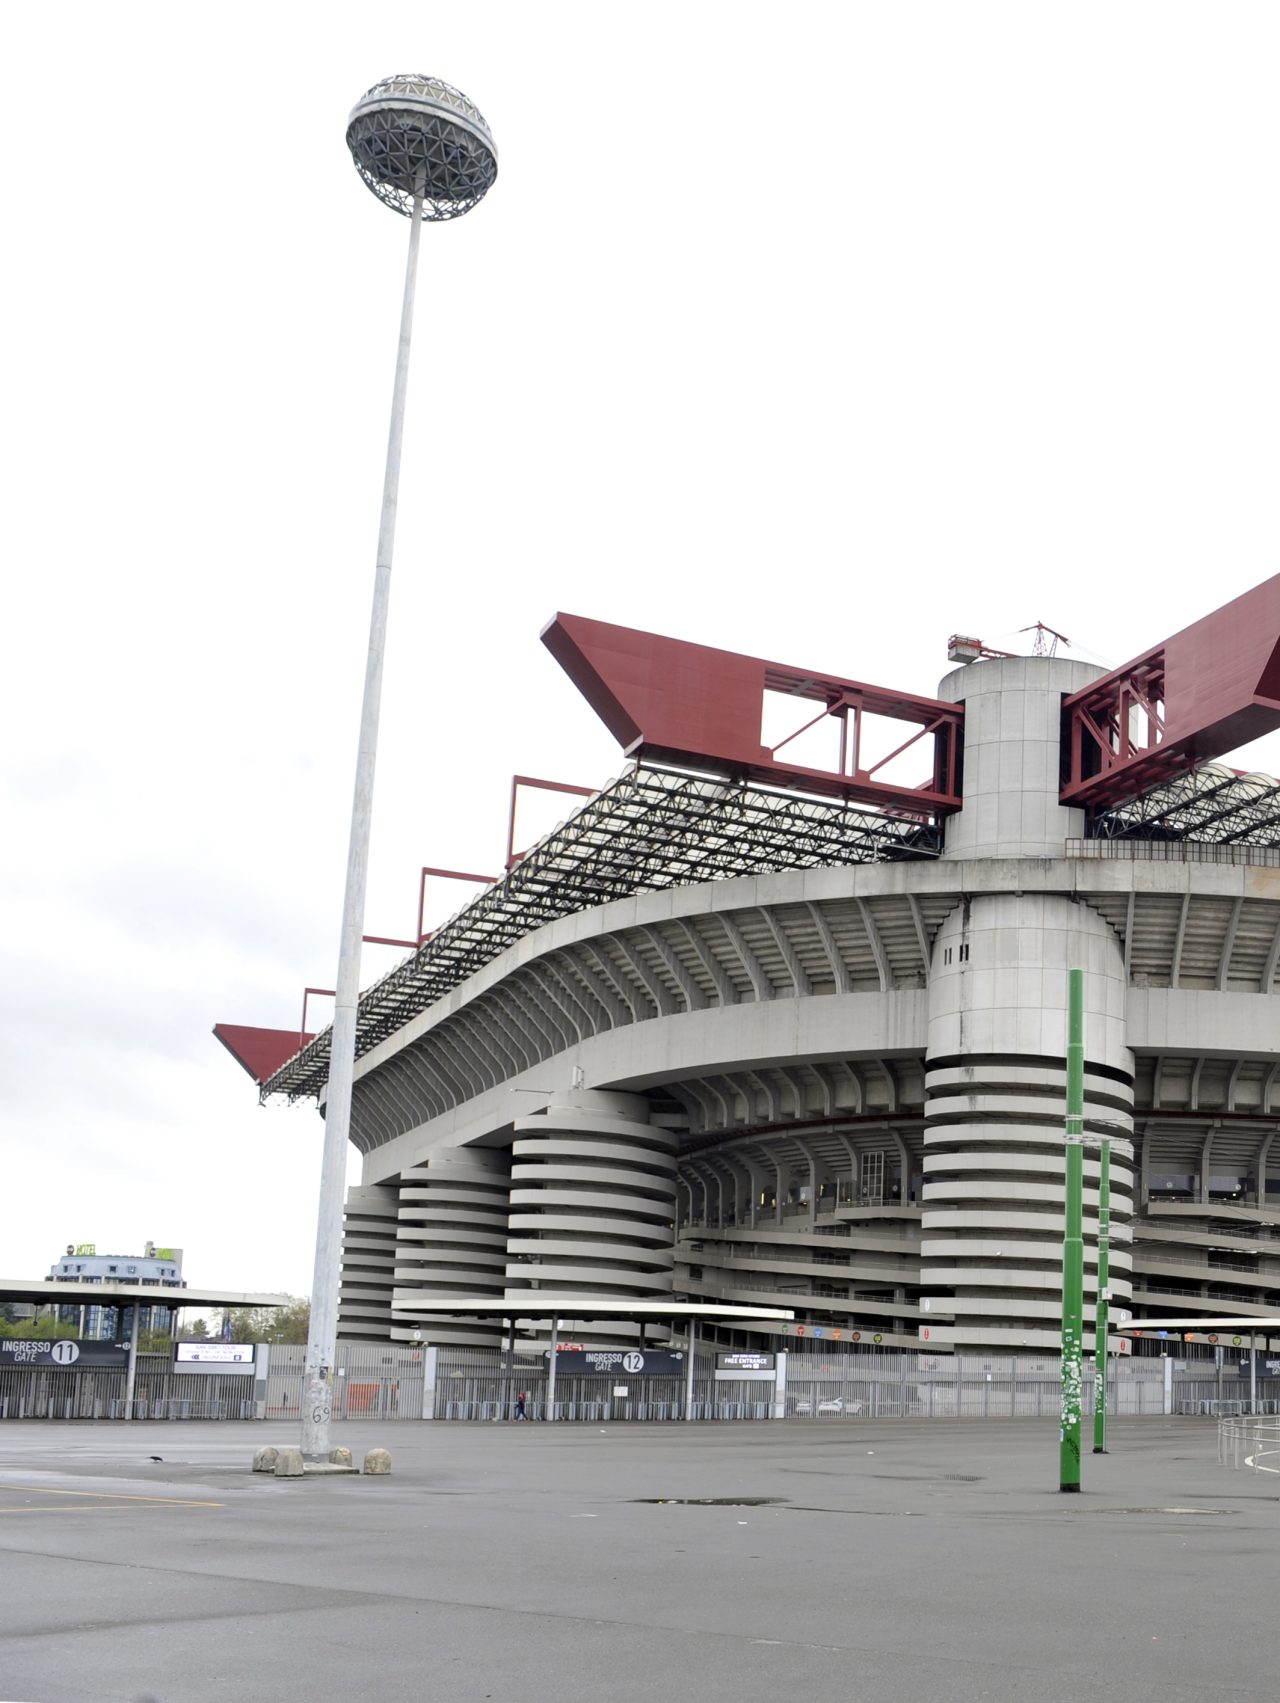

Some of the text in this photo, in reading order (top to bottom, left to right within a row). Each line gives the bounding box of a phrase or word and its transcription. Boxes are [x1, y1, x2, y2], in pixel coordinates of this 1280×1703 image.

[2, 1341, 74, 1362] INGRESSO 11
[14, 1351, 37, 1362] GATE
[585, 1352, 641, 1370] INGRESSO 12
[595, 1361, 612, 1371] GATE
[739, 1357, 767, 1365] ENTRANCE
[312, 1405, 330, 1424] 69
